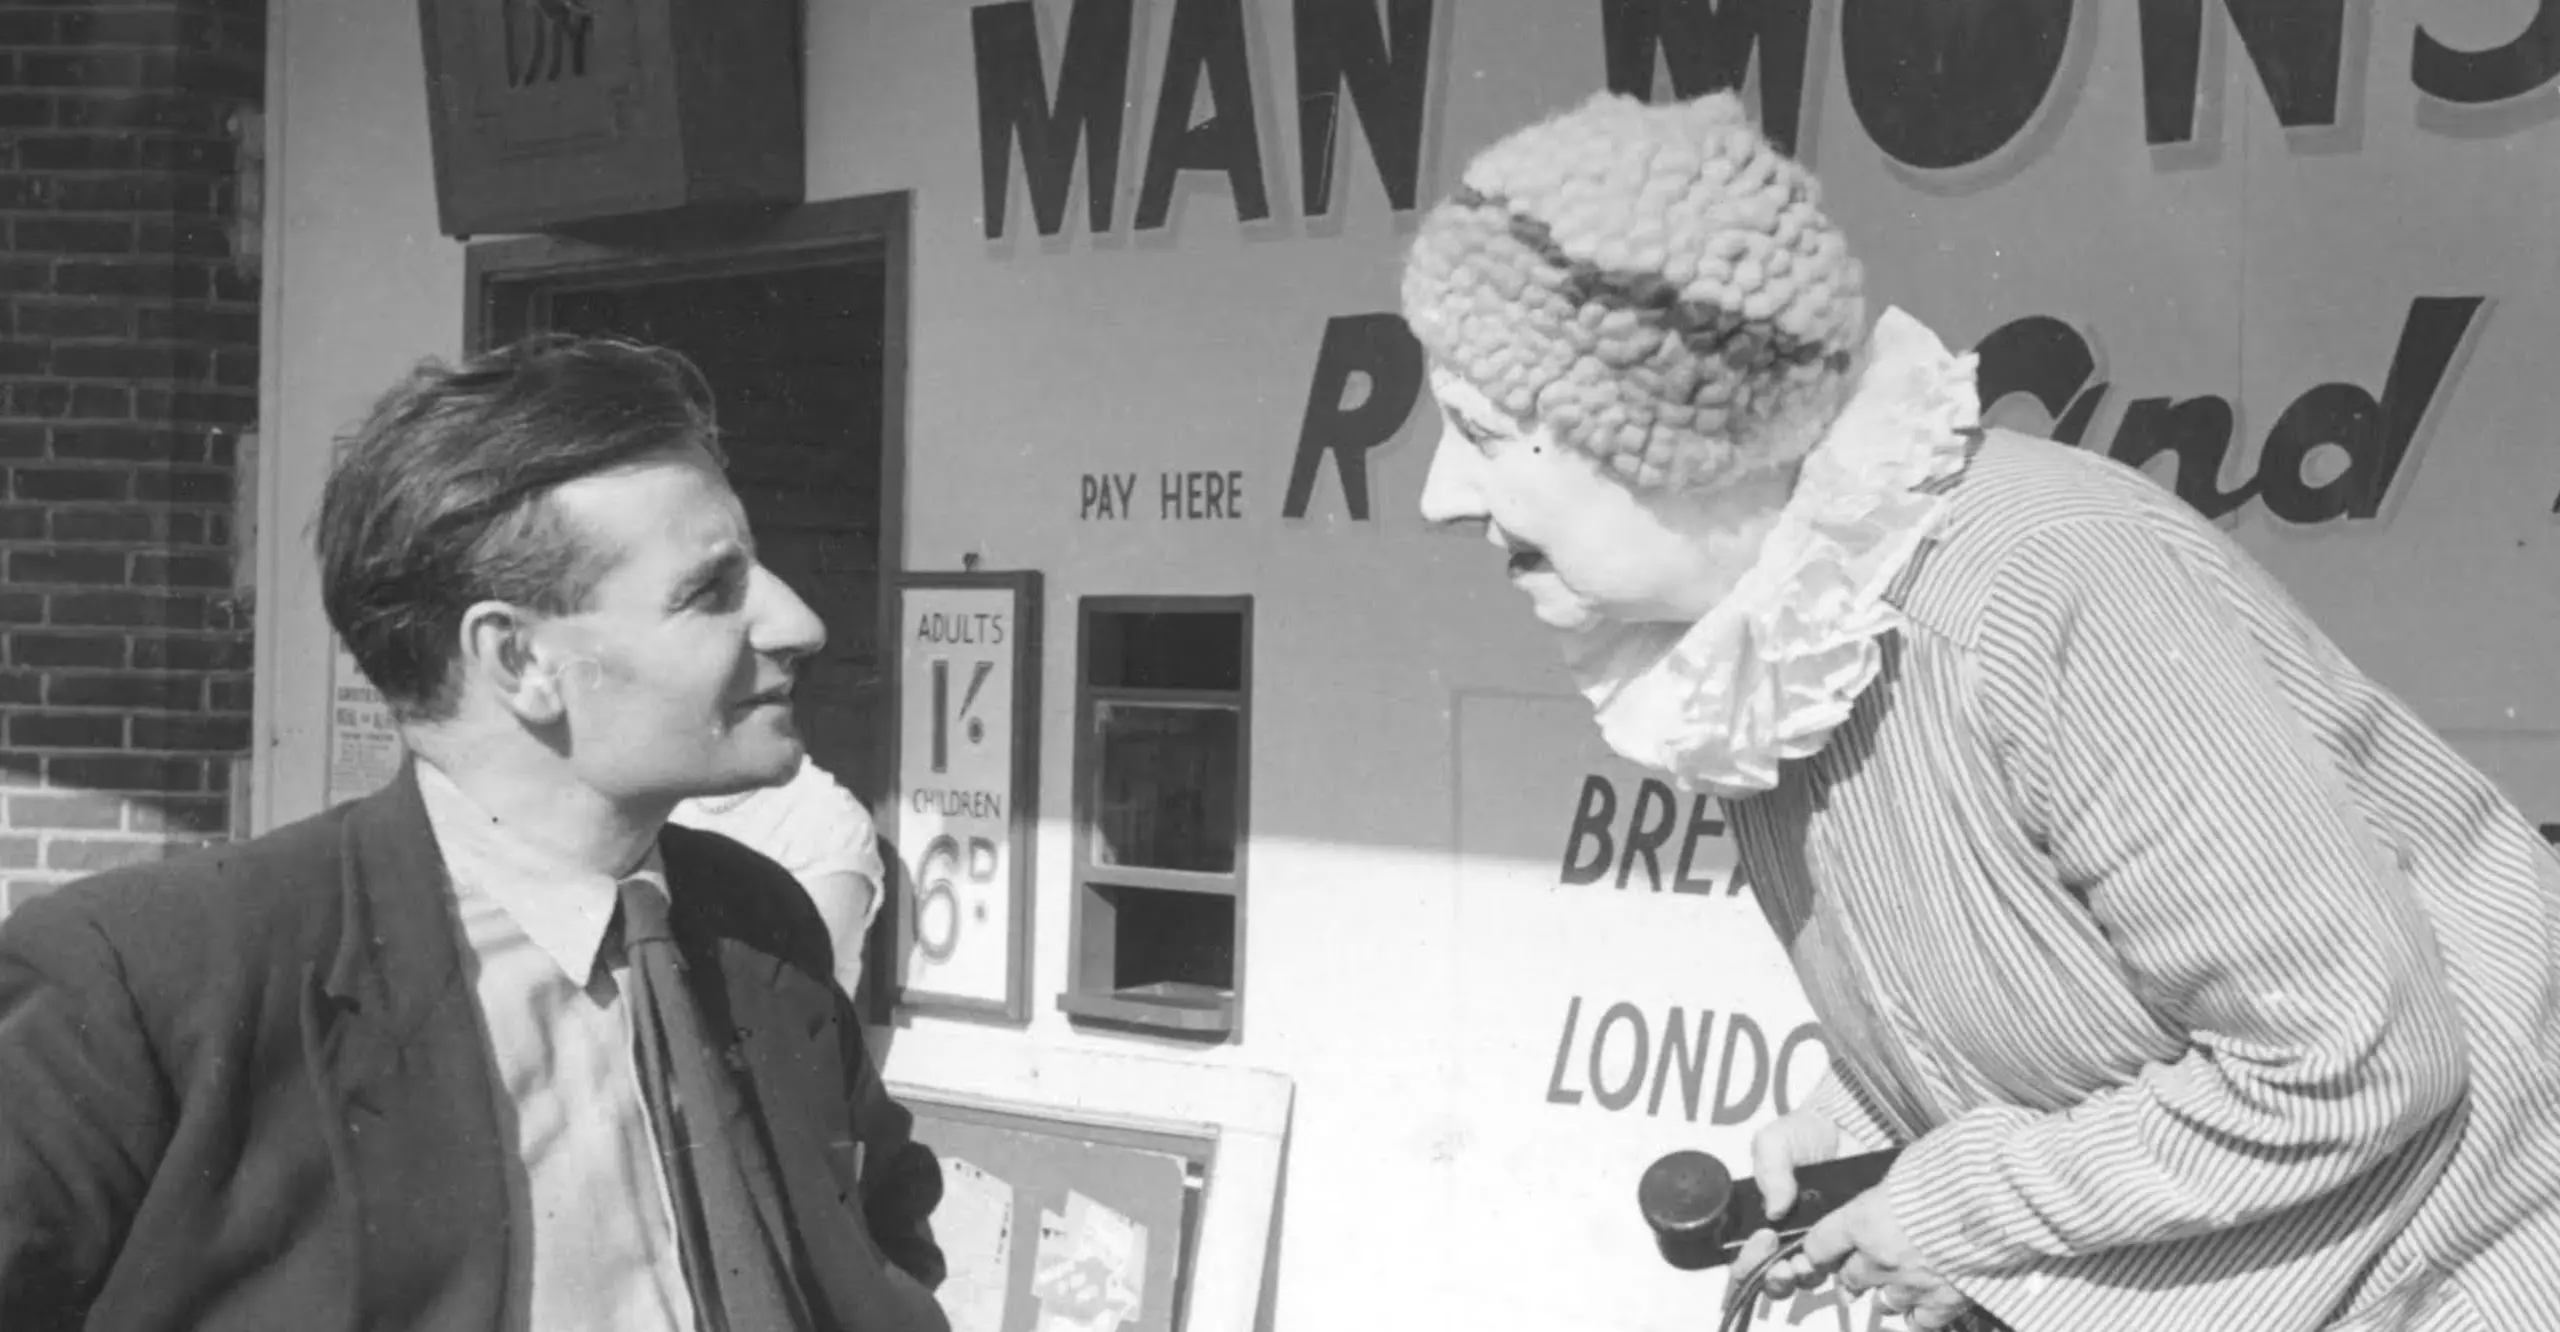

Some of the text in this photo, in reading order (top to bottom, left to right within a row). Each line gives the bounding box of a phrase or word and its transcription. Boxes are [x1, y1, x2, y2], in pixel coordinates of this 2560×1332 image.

[971, 0, 1434, 240] MAN
[1080, 470, 1243, 521] PAY HERE
[917, 612, 1004, 645] ADULTS
[912, 788, 1001, 821] CHILDREN
[1560, 774, 1751, 898] BRE
